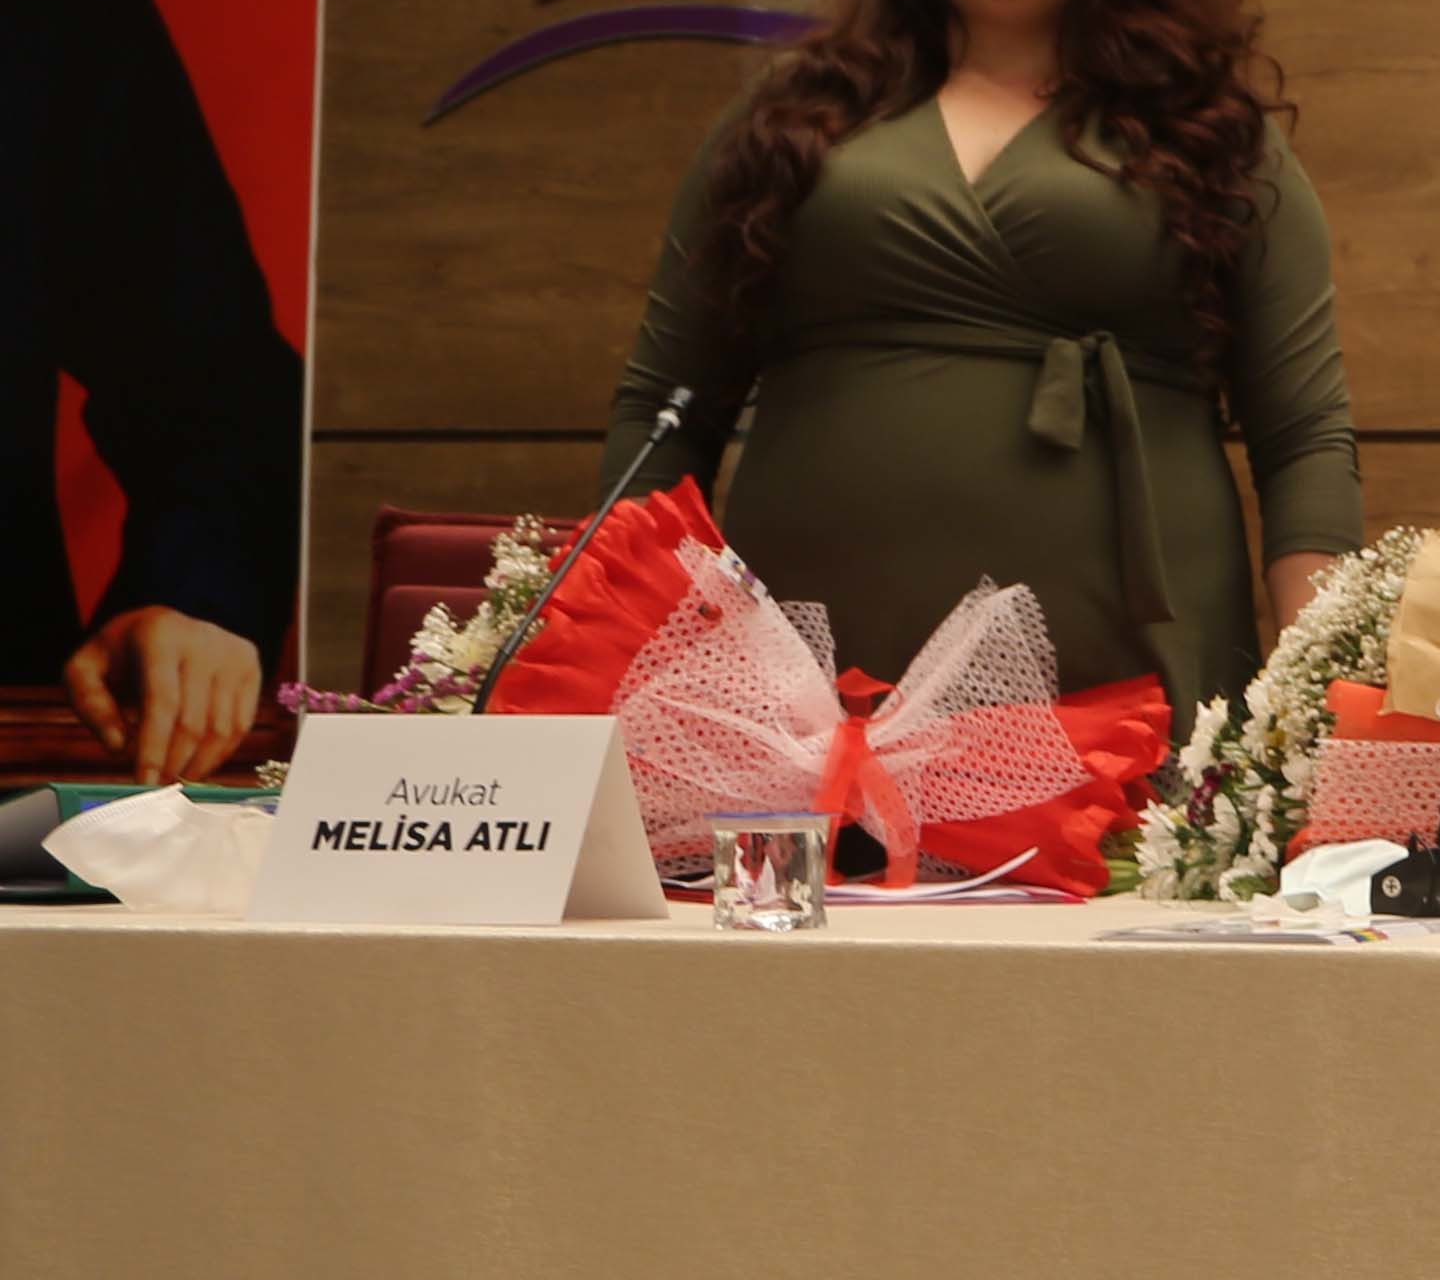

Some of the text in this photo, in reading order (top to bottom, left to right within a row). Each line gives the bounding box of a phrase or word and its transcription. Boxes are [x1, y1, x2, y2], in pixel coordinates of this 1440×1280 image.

[384, 776, 503, 807] Avukat
[310, 813, 552, 852] MELİSA ATLI
